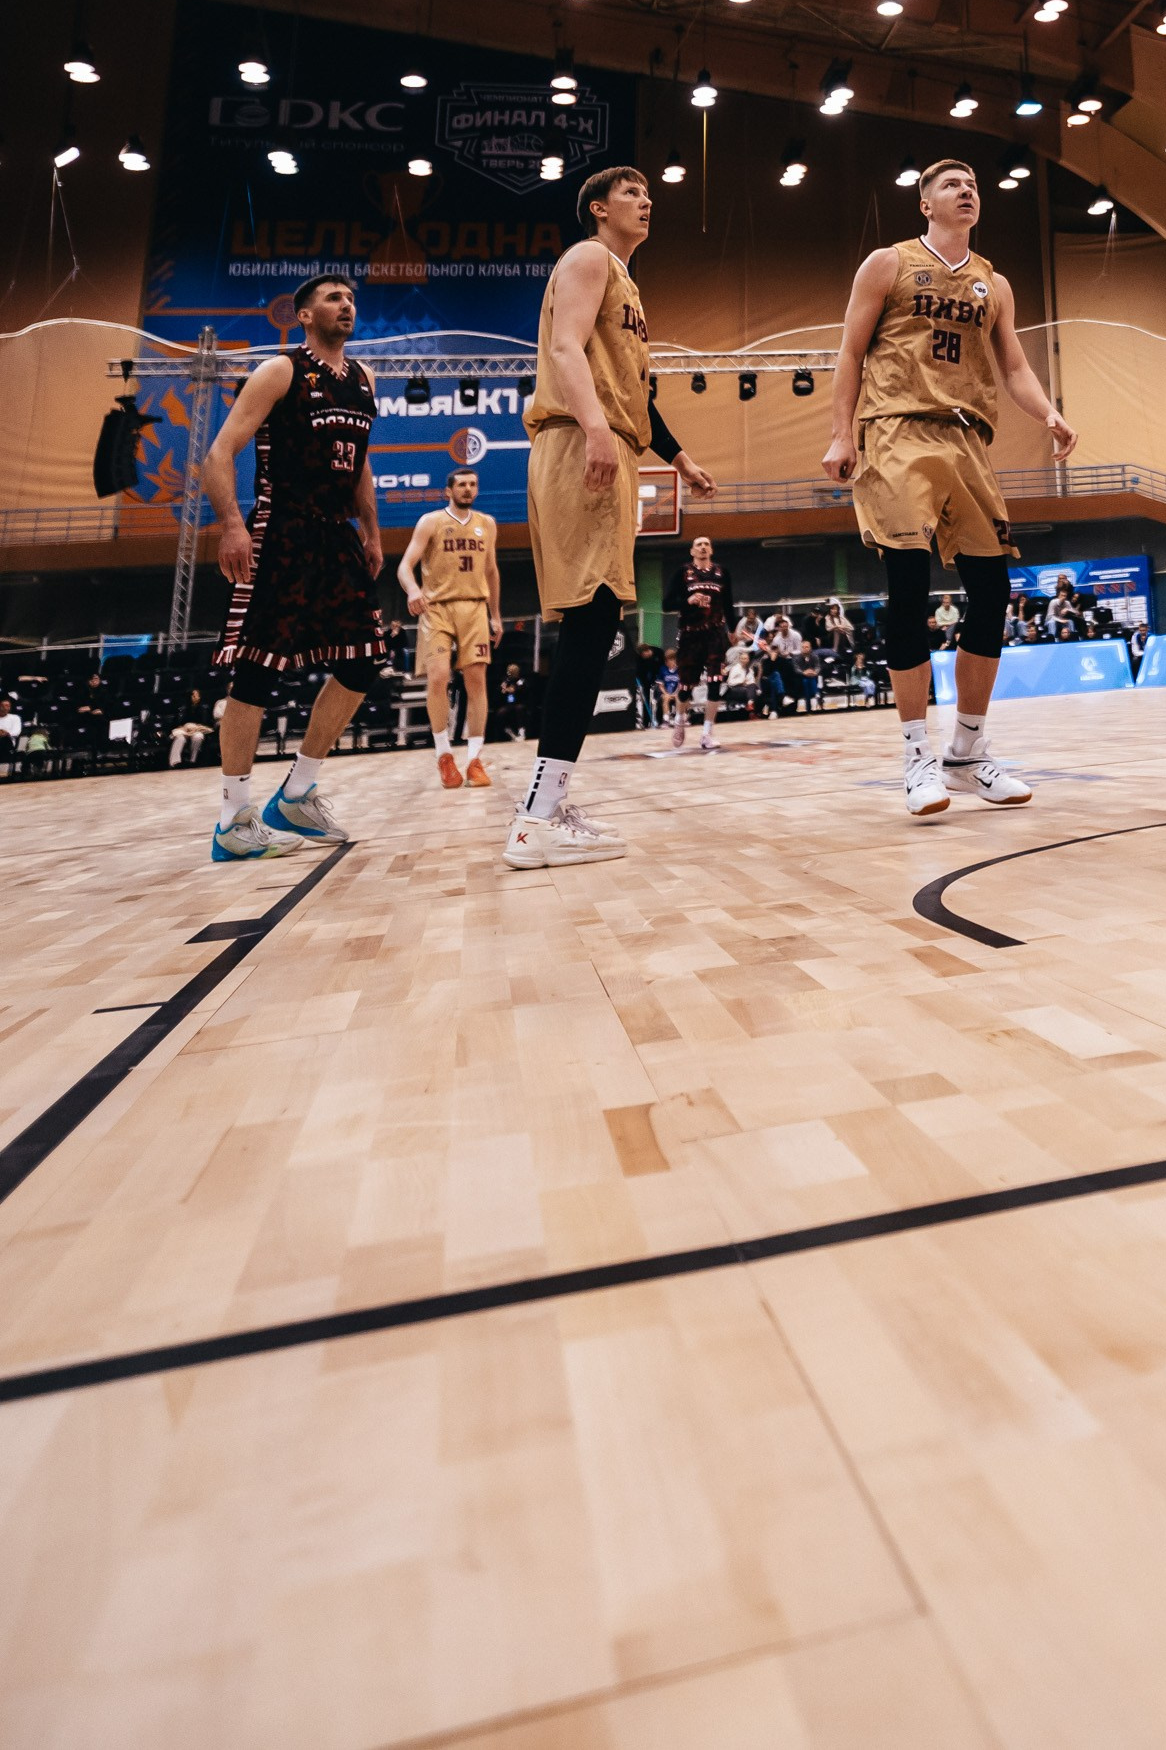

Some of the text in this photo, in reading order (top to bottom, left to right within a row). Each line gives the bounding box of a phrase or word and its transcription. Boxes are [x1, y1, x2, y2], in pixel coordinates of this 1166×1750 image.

[451, 109, 547, 130] ФИНАЛ
[231, 220, 562, 259] ЦЕЛЬ ОДНА
[228, 257, 320, 278] ЮБИЛЕЙНЫЙ
[353, 262, 475, 278] БАСКЕТБОЛЬНОГО
[478, 263, 521, 278] КЛУБА
[912, 294, 987, 329] ЦИВС
[931, 328, 962, 365] 28
[330, 440, 356, 472] 33
[442, 538, 485, 553] ЦИВС
[458, 556, 474, 573] 31
